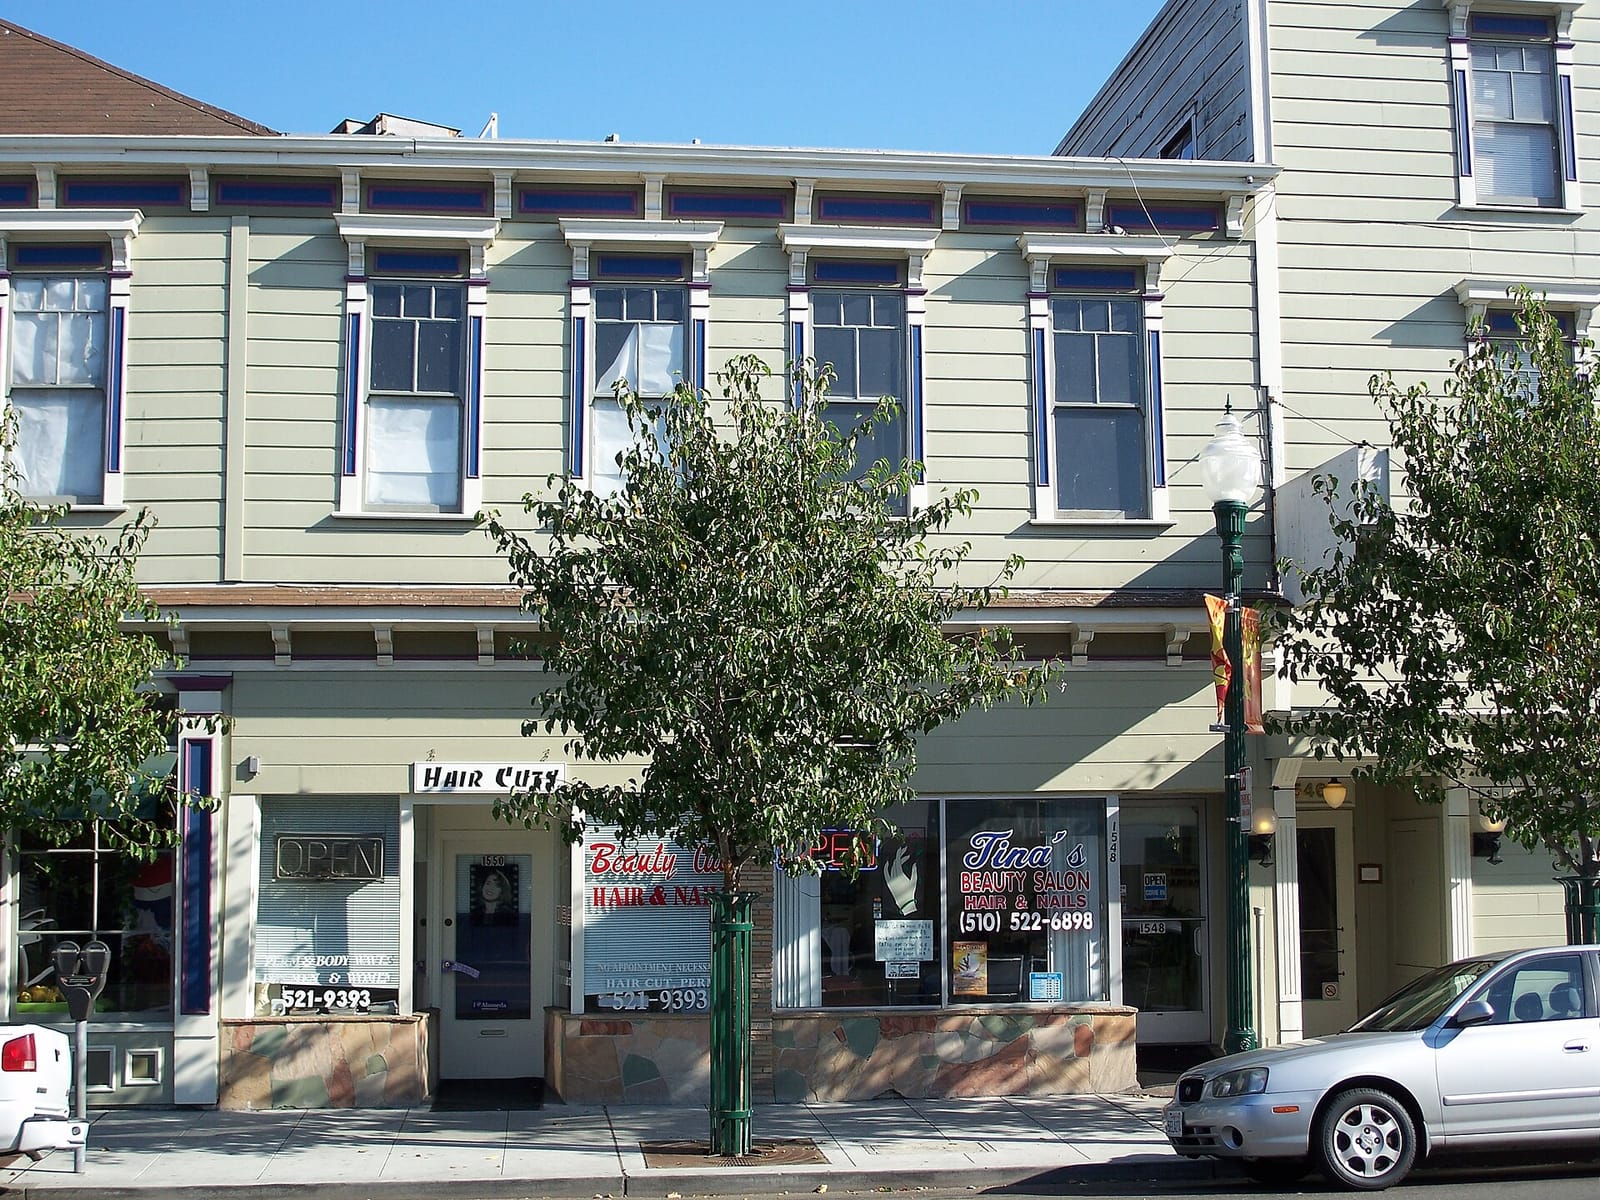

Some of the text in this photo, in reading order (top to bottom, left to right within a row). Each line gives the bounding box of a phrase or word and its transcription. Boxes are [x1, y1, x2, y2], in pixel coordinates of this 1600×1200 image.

[424, 767, 483, 788] HAIR
[780, 833, 876, 866] PEN
[963, 829, 1087, 869] Tina's
[1109, 821, 1118, 863] 1548
[280, 841, 377, 875] OPEN
[482, 856, 505, 866] 1550
[589, 842, 678, 880] Beauty
[960, 871, 1091, 893] BEAUTY SALON
[1145, 875, 1165, 886] OPEN
[593, 886, 644, 907] HAIR
[650, 886, 667, 907] &
[964, 894, 1087, 910] HAIR & NAILS
[959, 911, 1093, 933] (510) 522-6898
[1140, 923, 1165, 933] 1548
[316, 955, 349, 967] BODY
[328, 972, 341, 984] &
[606, 979, 639, 989] HAIR
[282, 990, 371, 1008] 521-9393
[612, 989, 707, 1010] 521-9393
